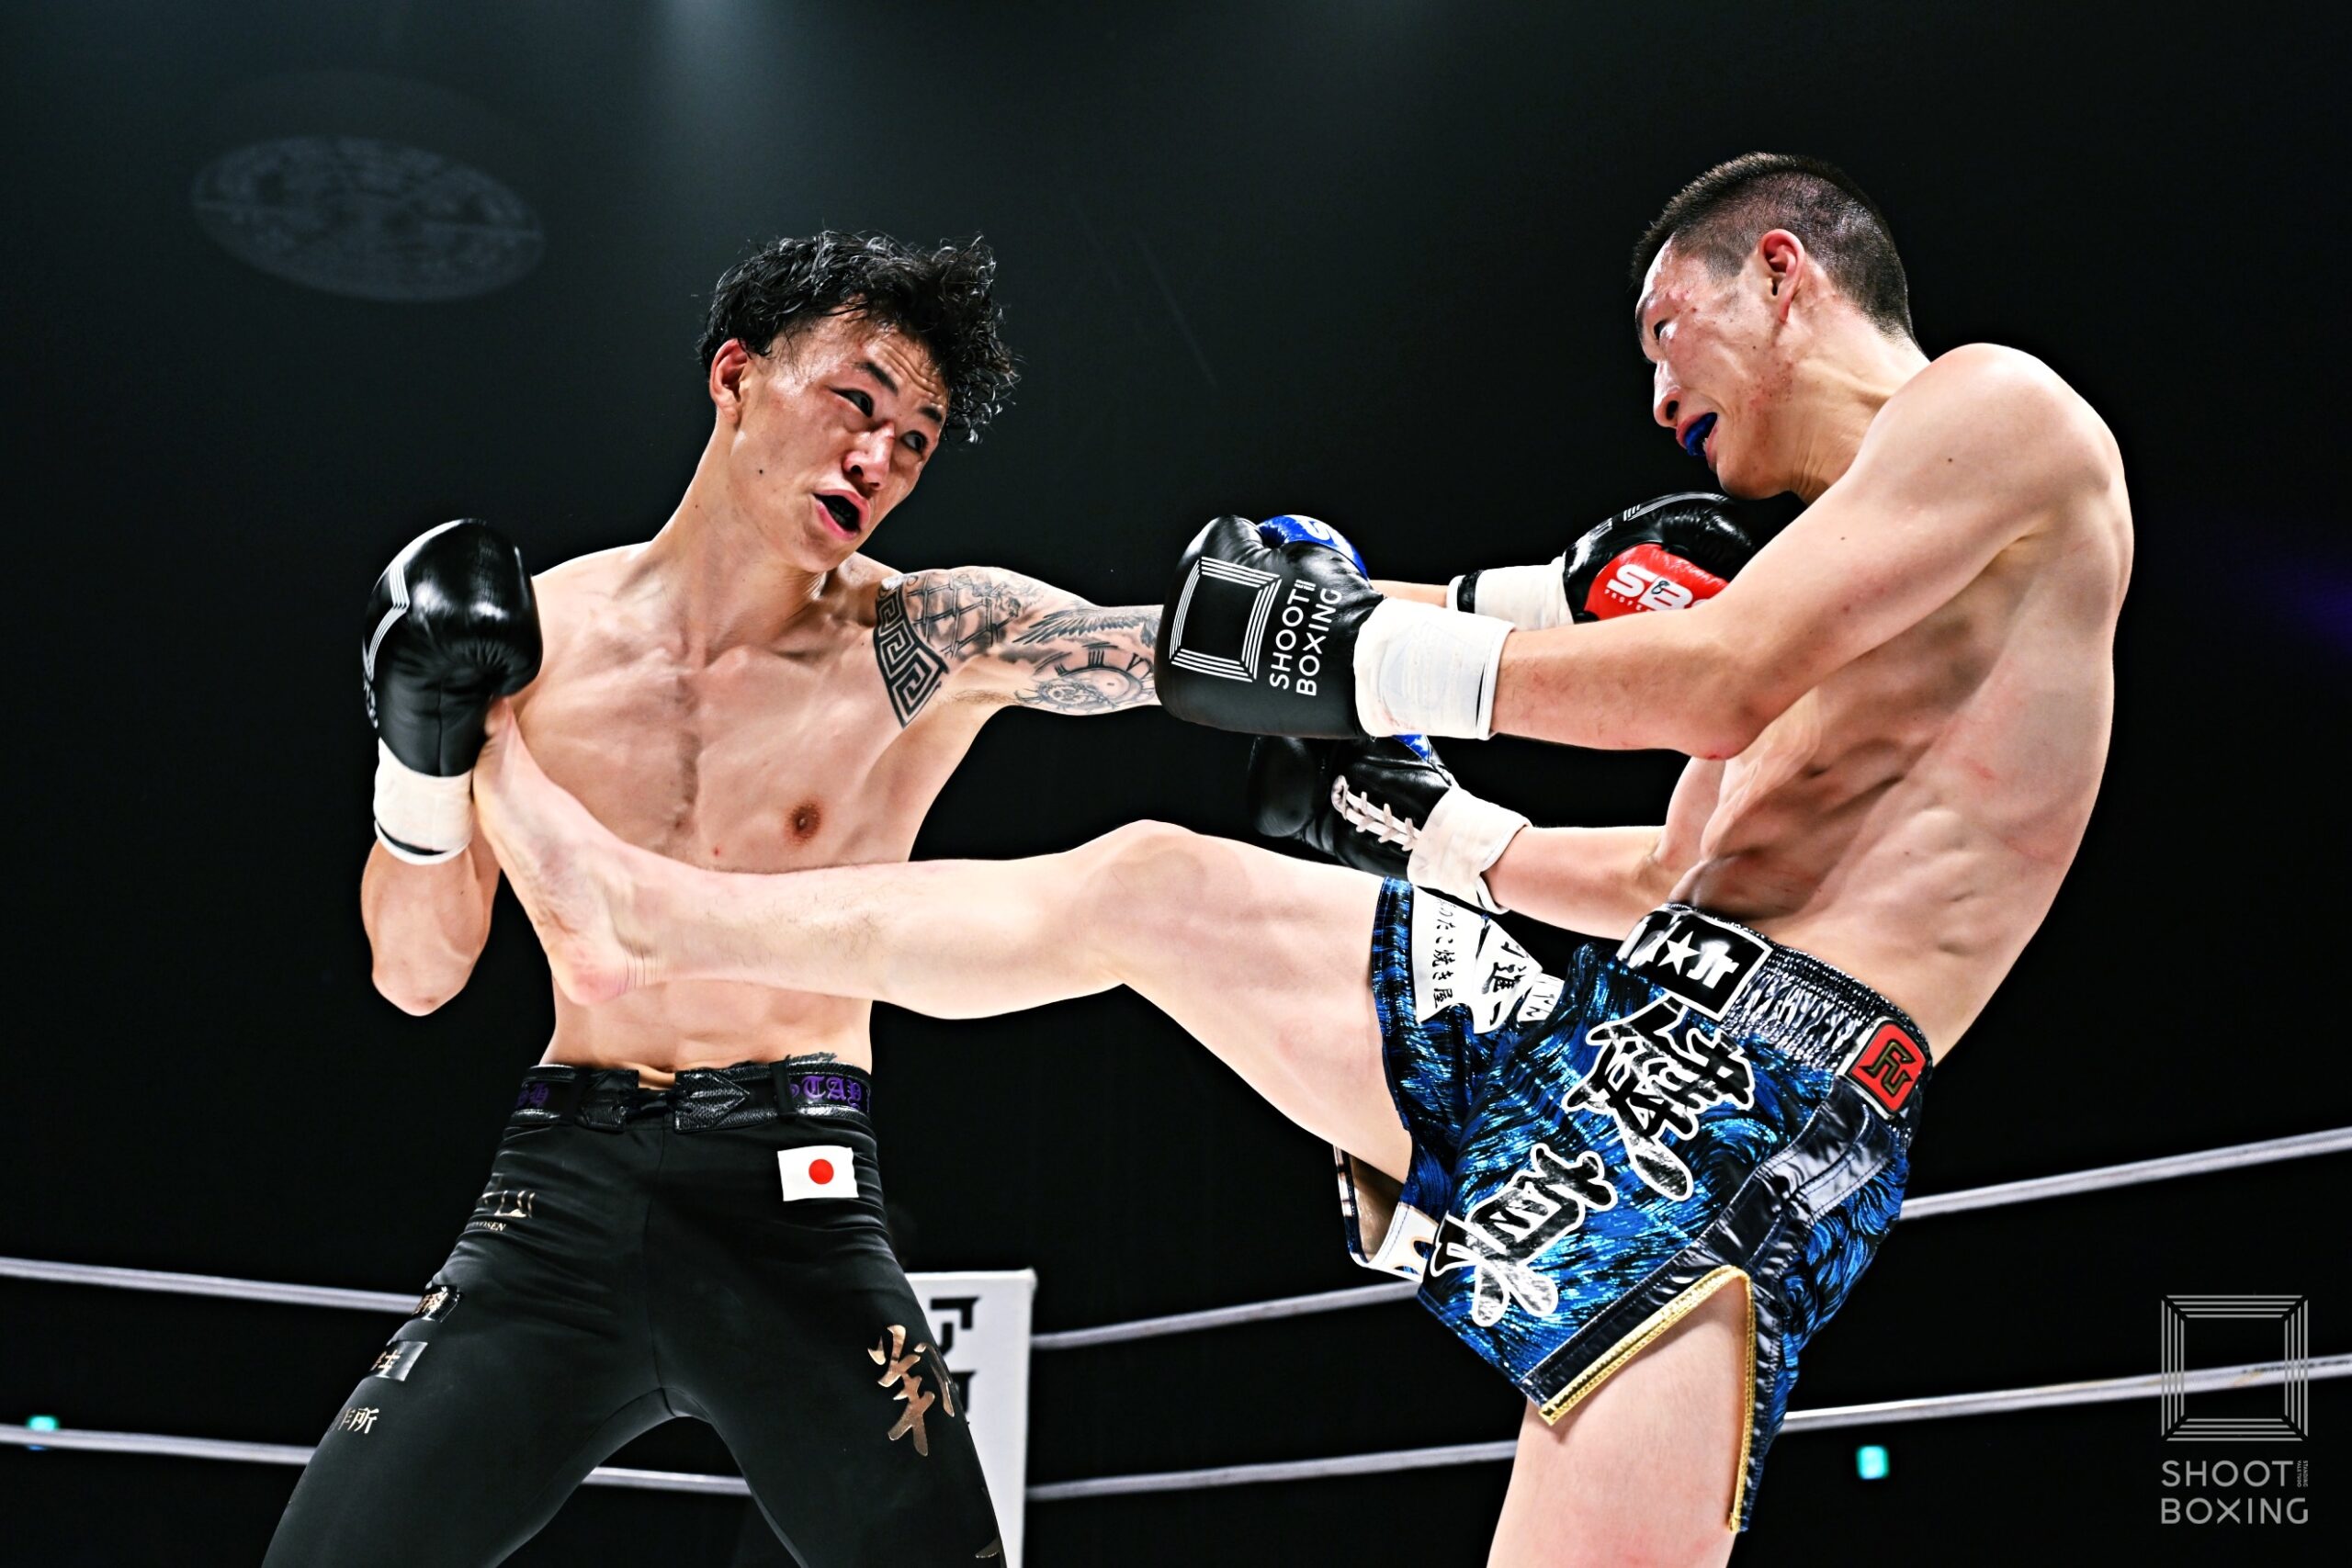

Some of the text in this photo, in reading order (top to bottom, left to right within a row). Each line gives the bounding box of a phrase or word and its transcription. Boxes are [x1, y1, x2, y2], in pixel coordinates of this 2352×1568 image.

[1604, 588, 1653, 612] PROFE
[1606, 563, 1709, 612] SB
[1269, 588, 1311, 690] SHOOT
[1295, 588, 1342, 697] BOXING
